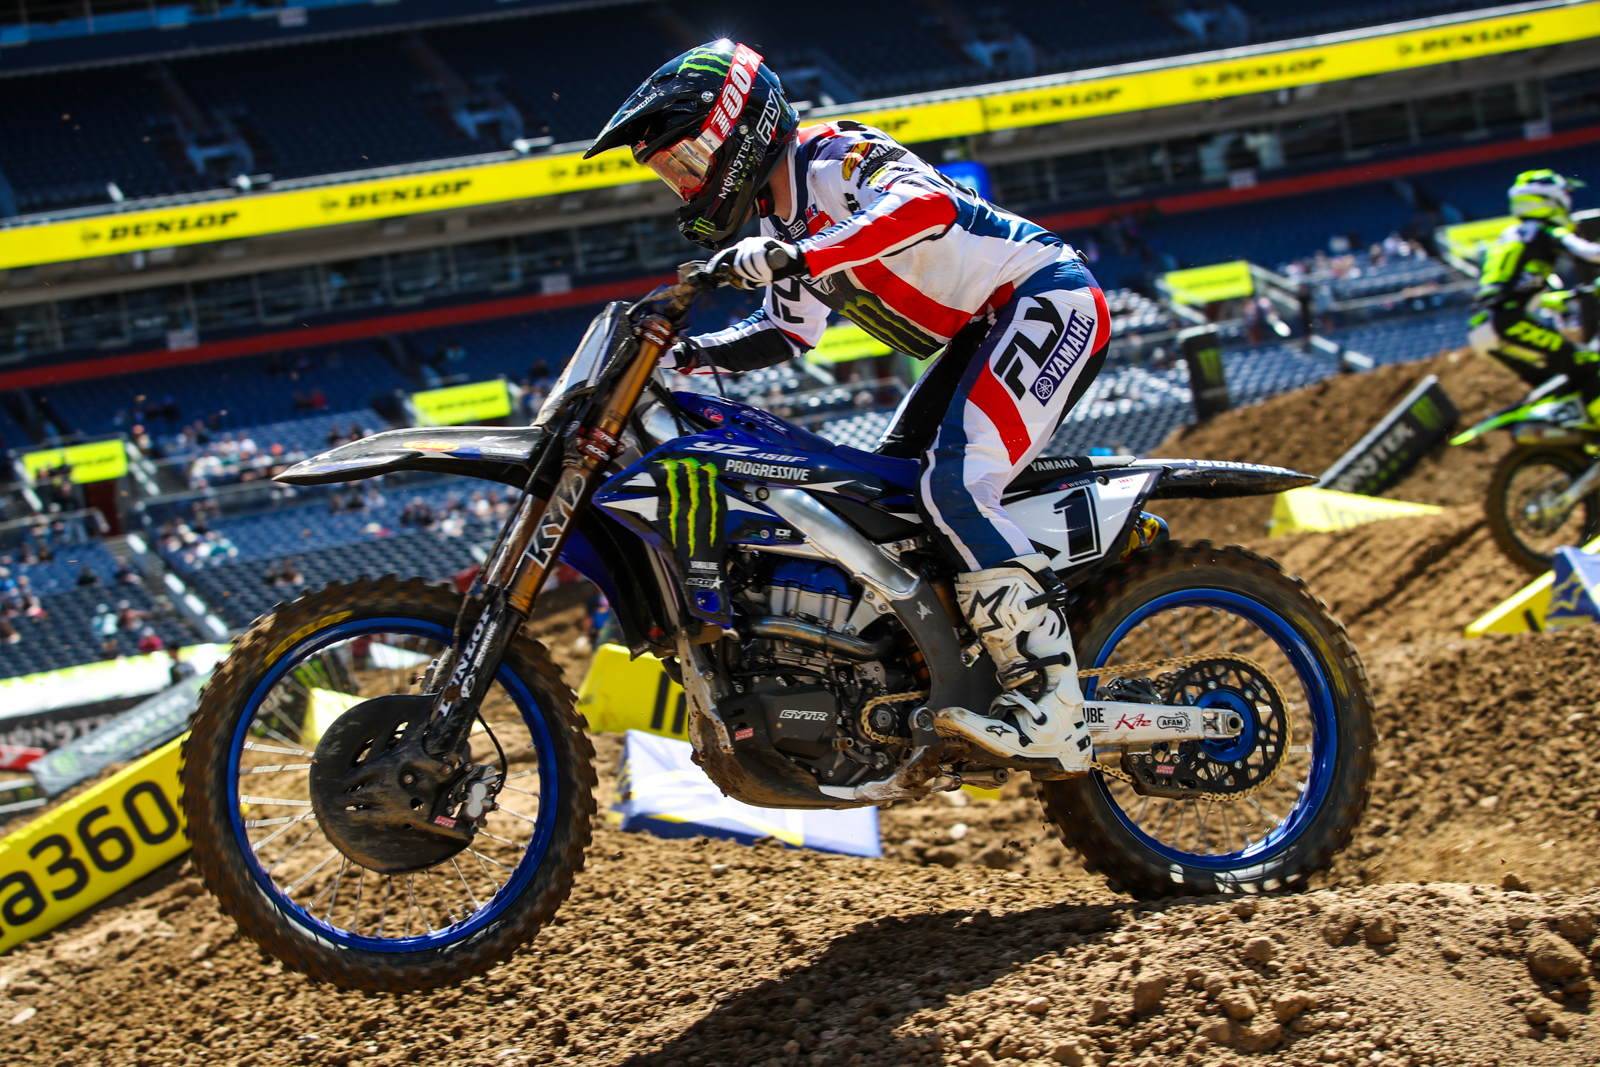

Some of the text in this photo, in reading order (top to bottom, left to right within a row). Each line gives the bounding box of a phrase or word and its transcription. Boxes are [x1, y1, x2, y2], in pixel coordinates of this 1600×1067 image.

[1421, 24, 1532, 53] DUNLOP
[1215, 57, 1325, 84] DUNLOP
[711, 47, 760, 137] 100%
[1010, 88, 1121, 114] DUNLOP
[756, 88, 781, 145] FLY
[574, 159, 634, 177] DUN
[719, 134, 755, 199] MONSTER
[735, 146, 757, 192] ENERGY
[346, 180, 471, 208] DUNLOP
[109, 212, 239, 240] DUNLOP
[993, 296, 1064, 401] FLY
[1045, 311, 1093, 380] YAMAHA
[725, 459, 810, 481] PROGRESSIVE
[1030, 459, 1079, 472] YAMAHA
[1327, 422, 1416, 492] ONSTER
[1053, 487, 1102, 562] 1
[779, 710, 828, 721] GYTR
[1115, 713, 1152, 730] Kite
[1162, 719, 1183, 727] AFAM
[0, 781, 178, 928] a360
